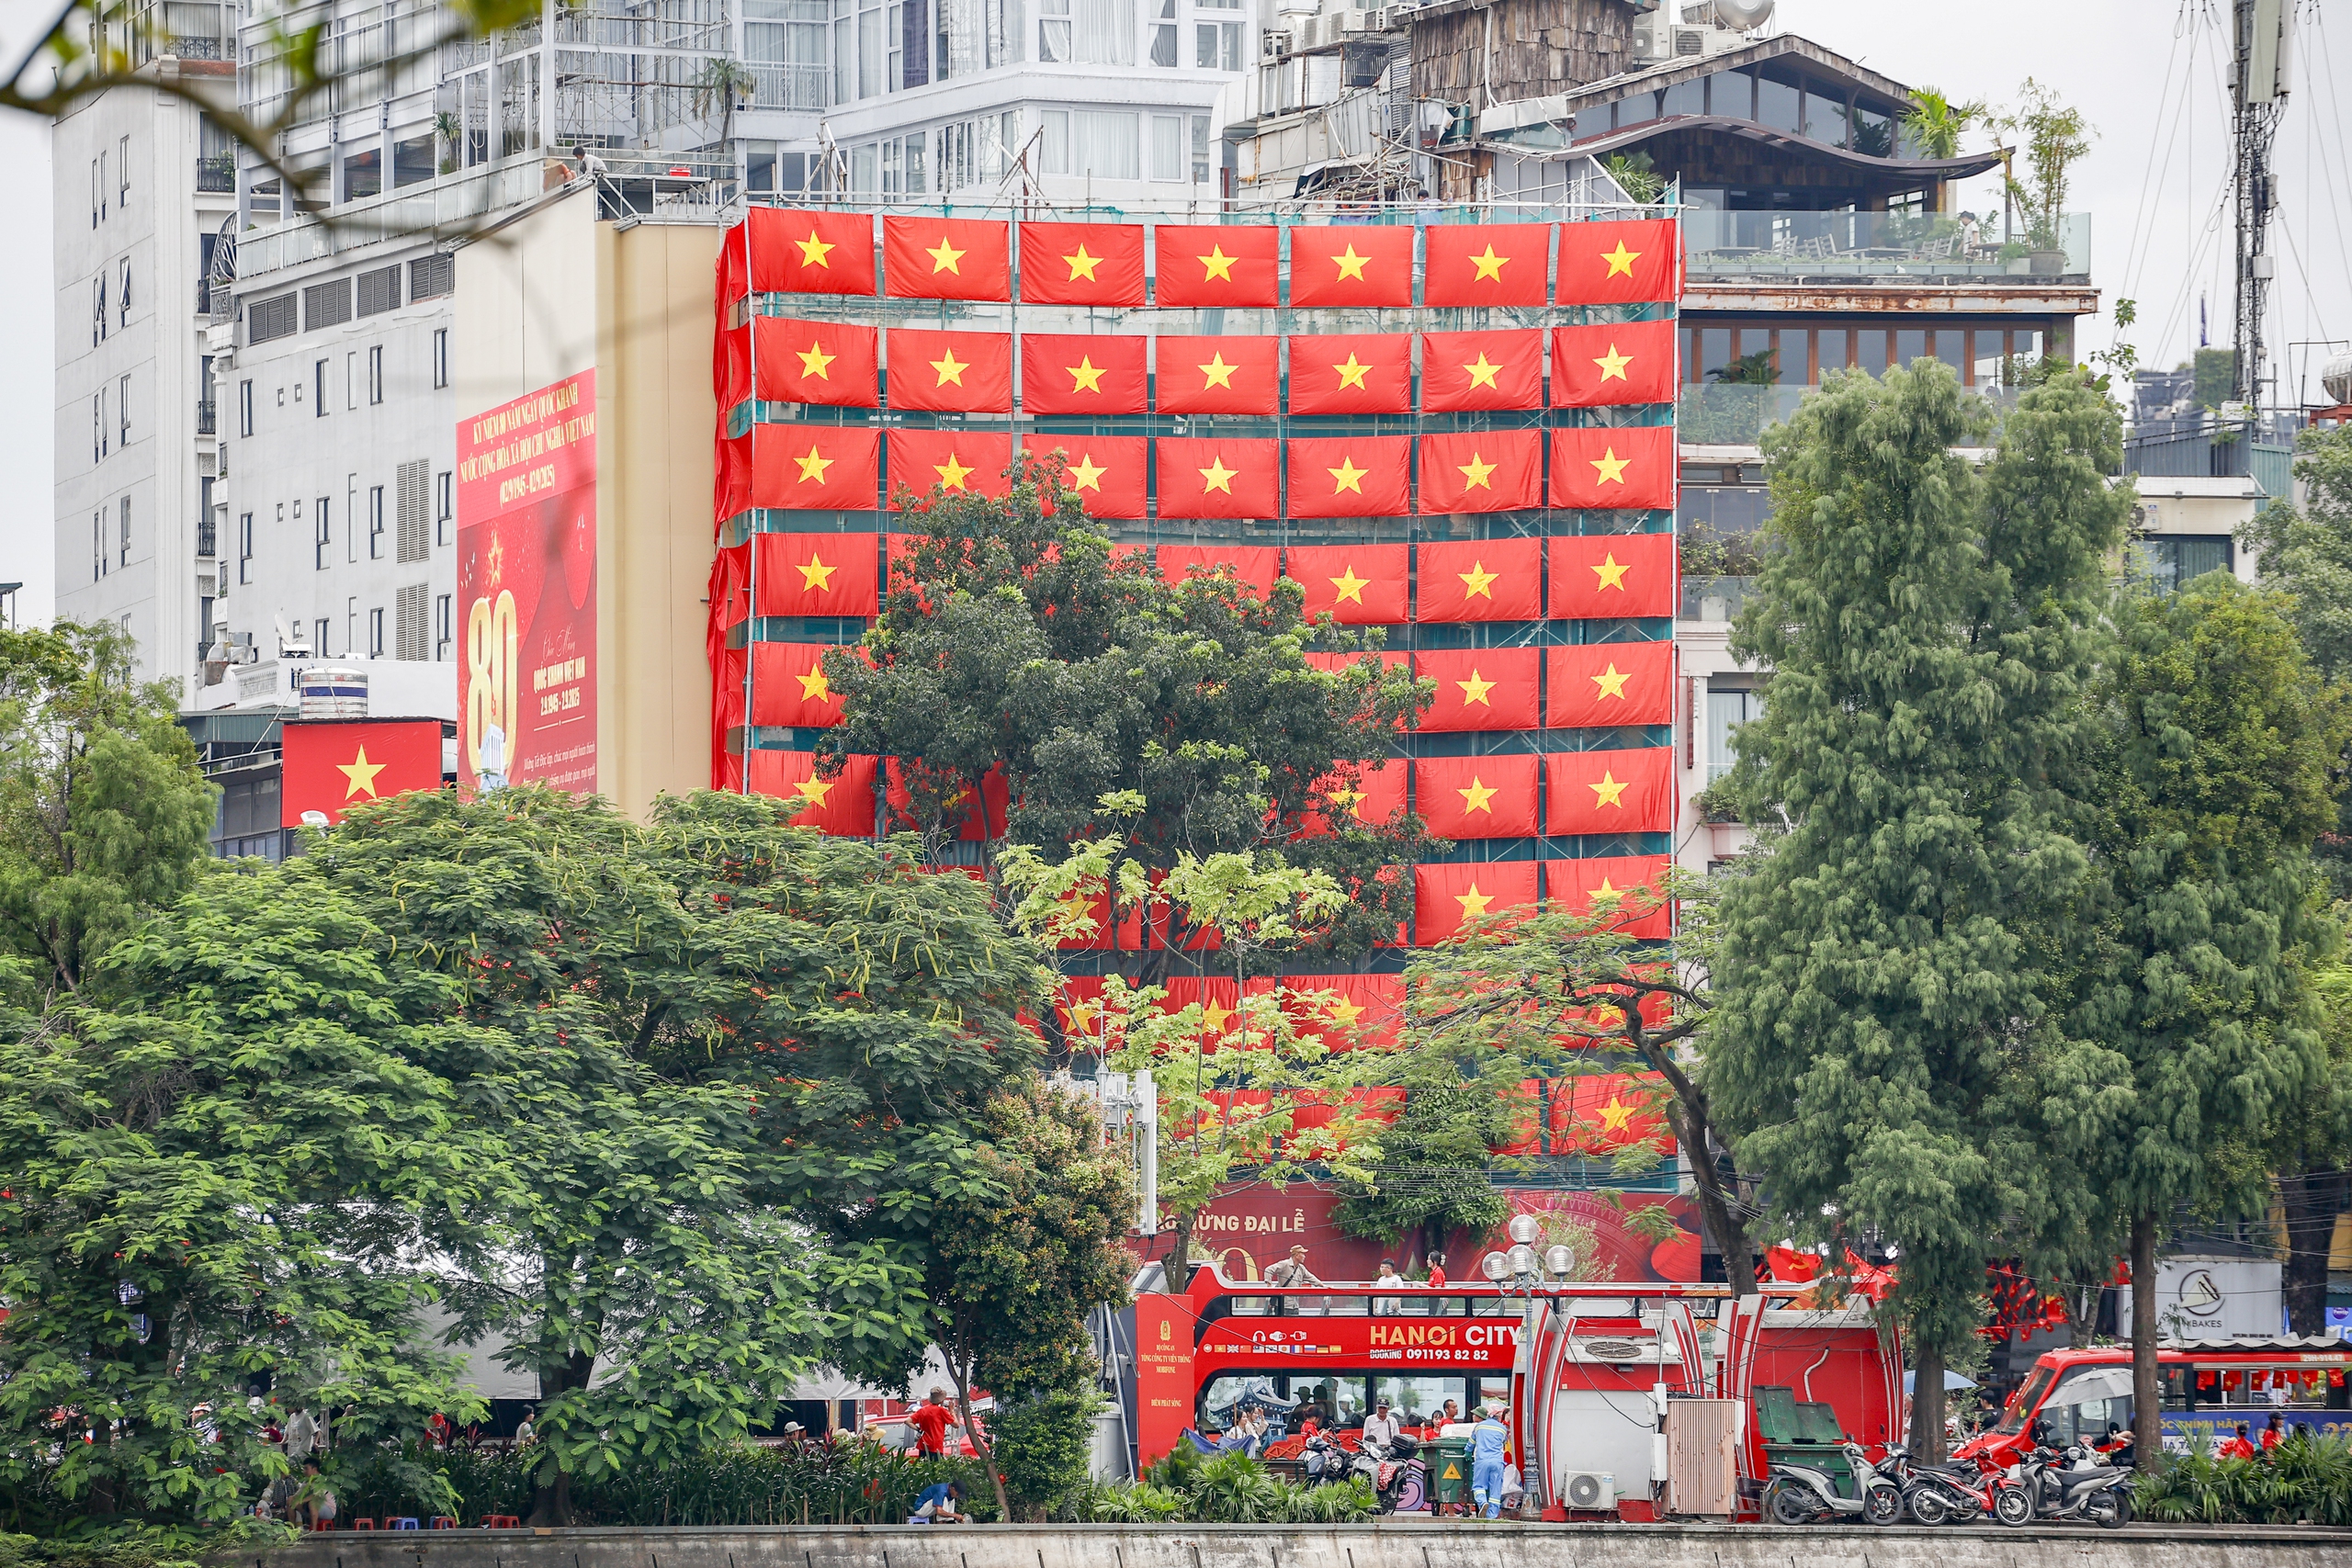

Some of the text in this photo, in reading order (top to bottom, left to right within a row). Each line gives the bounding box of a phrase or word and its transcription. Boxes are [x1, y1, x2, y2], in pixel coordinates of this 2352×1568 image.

[467, 589, 517, 776] 80
[1244, 1215, 1276, 1235] ĐẠI
[1282, 1208, 1305, 1233] LỄ
[2188, 1319, 2222, 1327] BAKES
[1370, 1325, 1521, 1346] HANOI CITY
[1370, 1349, 1488, 1360] BOOKING 091193 82 82
